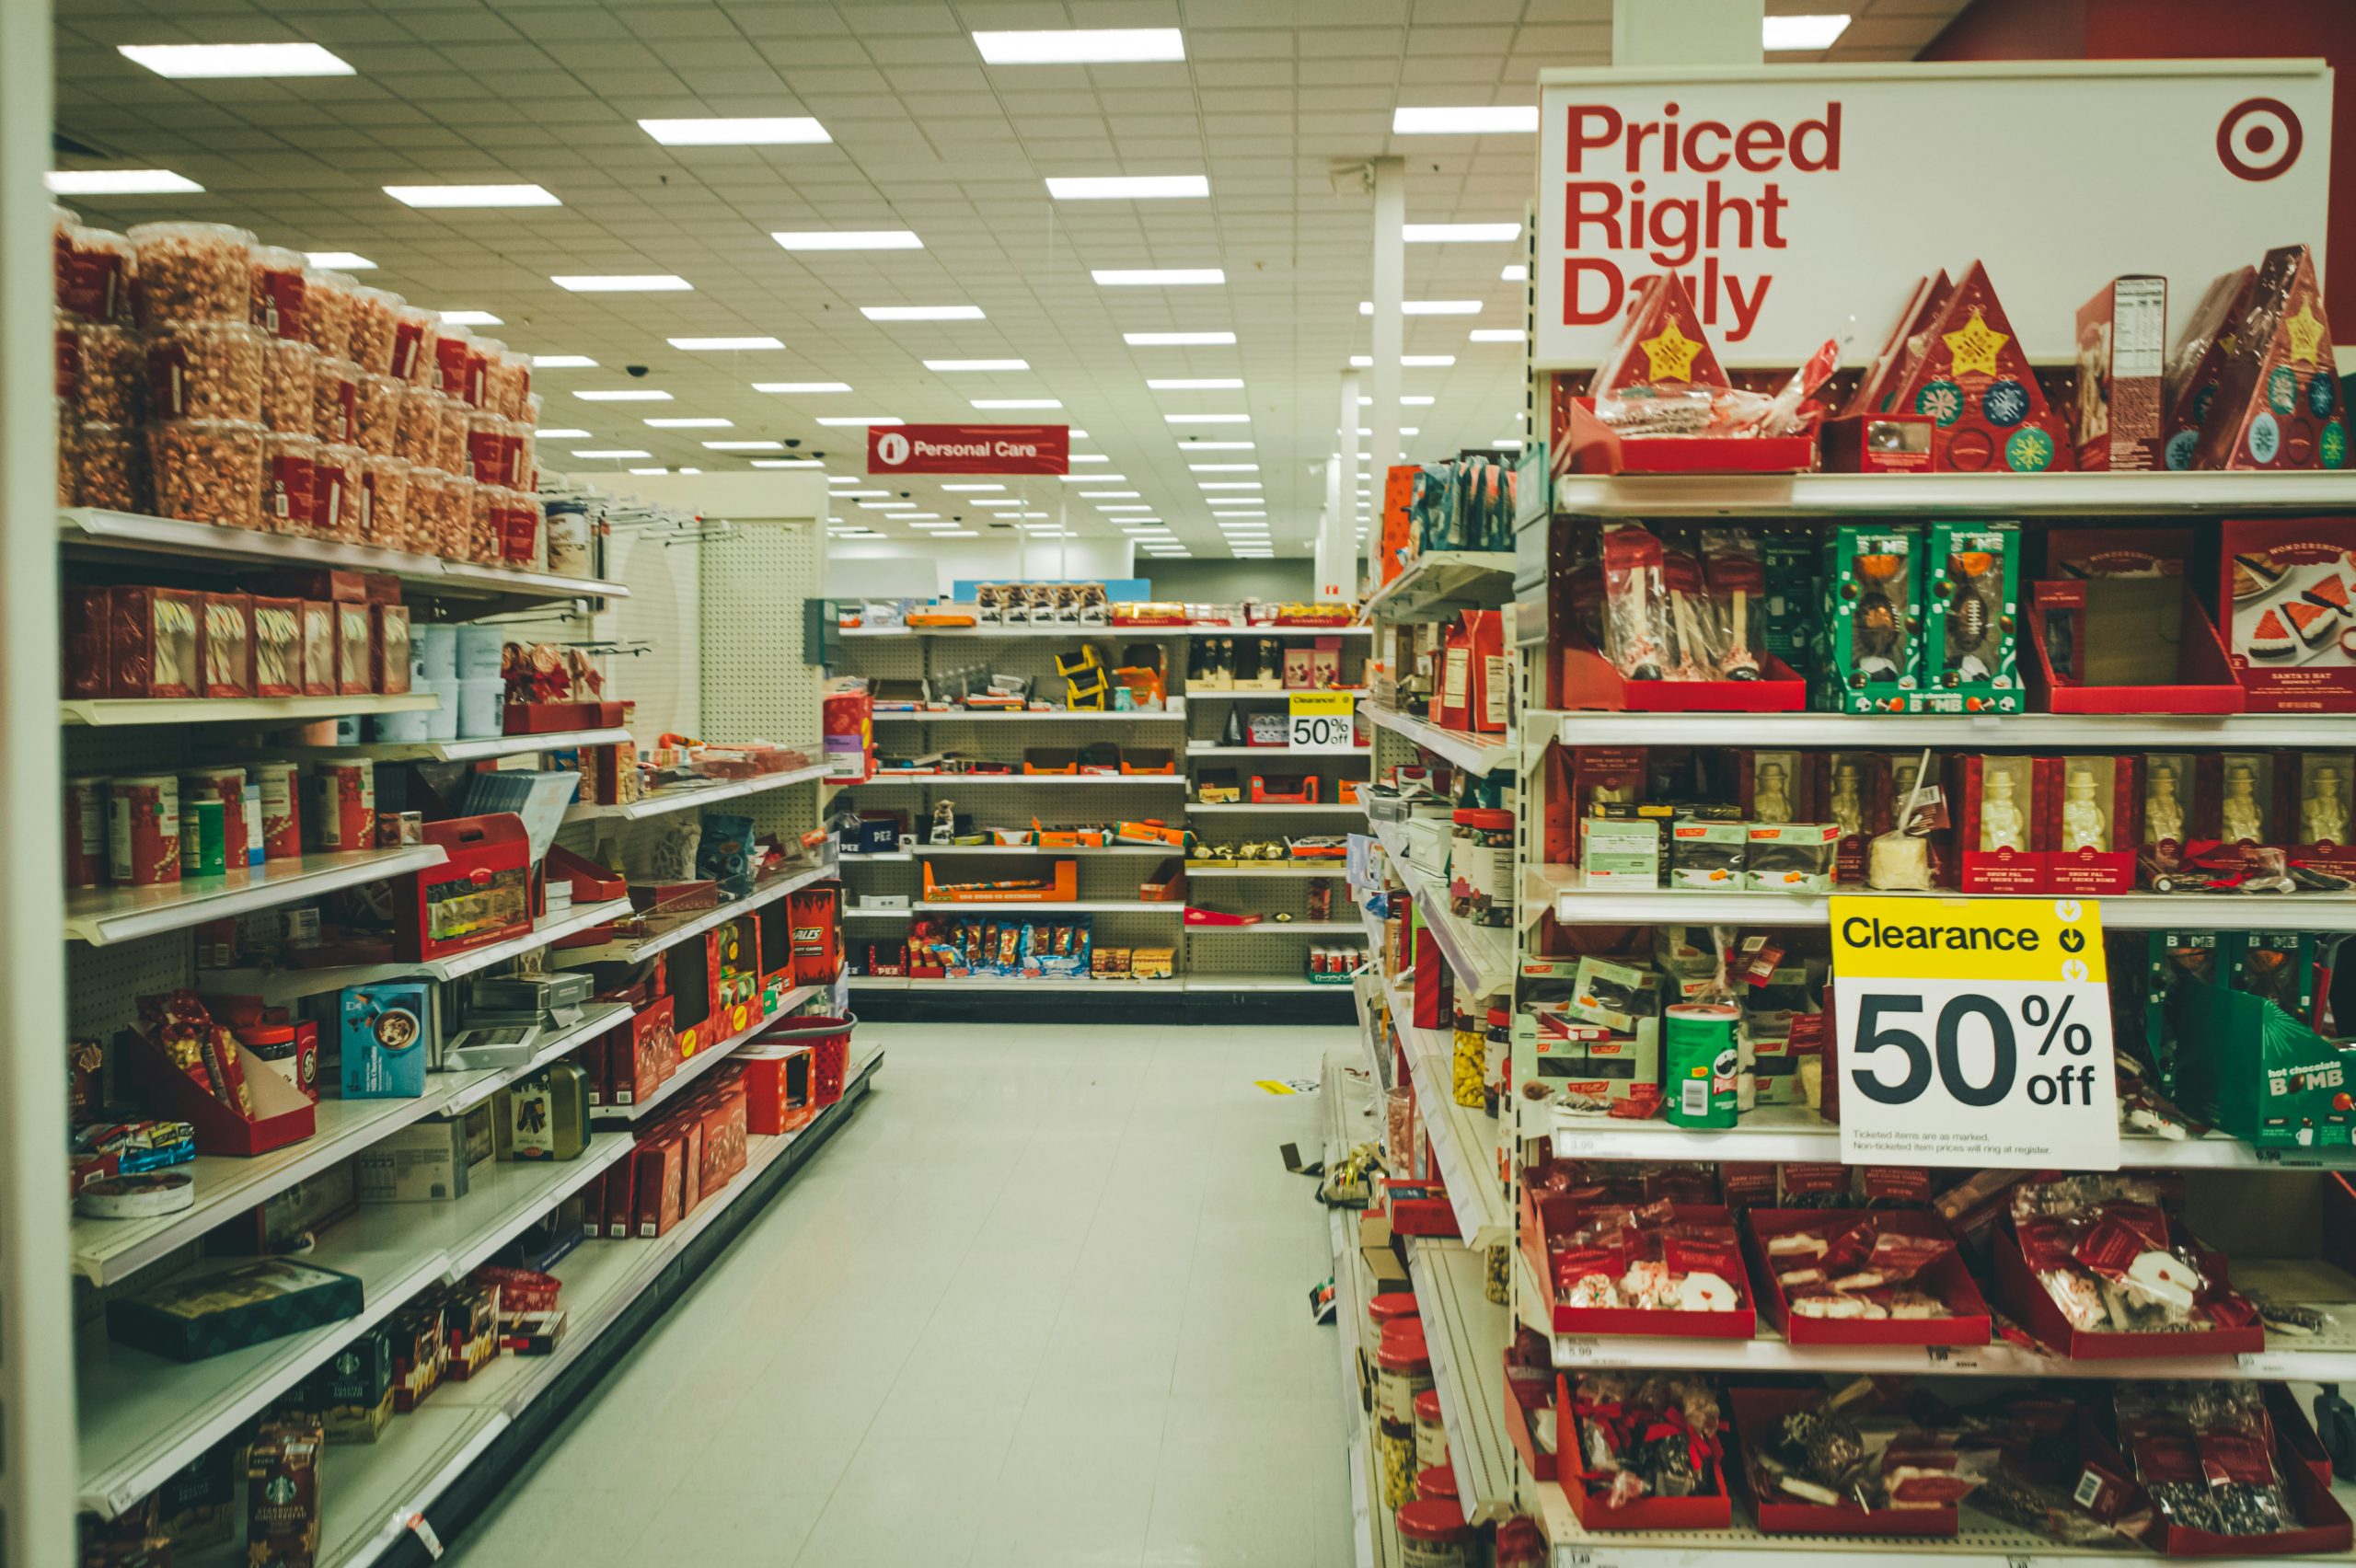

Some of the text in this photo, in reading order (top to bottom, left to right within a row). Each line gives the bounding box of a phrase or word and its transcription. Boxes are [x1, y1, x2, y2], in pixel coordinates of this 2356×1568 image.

[1566, 101, 1842, 173] Priced
[1565, 179, 1788, 268] Right
[1564, 257, 1773, 342] Dly
[914, 441, 1037, 457] Personal Care
[1331, 733, 1348, 744] off
[873, 830, 892, 843] PEZ
[841, 844, 860, 852] PEZ
[1842, 917, 2039, 951] Clearance
[878, 967, 898, 975] PEZ
[2268, 1060, 2342, 1078] hot chocolate
[2027, 1065, 2096, 1106] off
[1853, 1129, 1892, 1139] Ticketed
[1894, 1130, 1920, 1140] items
[1939, 1133, 1950, 1141] as
[1953, 1132, 1990, 1142] marked.
[1854, 1142, 2051, 1155] Non-ticketed item prices will ring at register.
